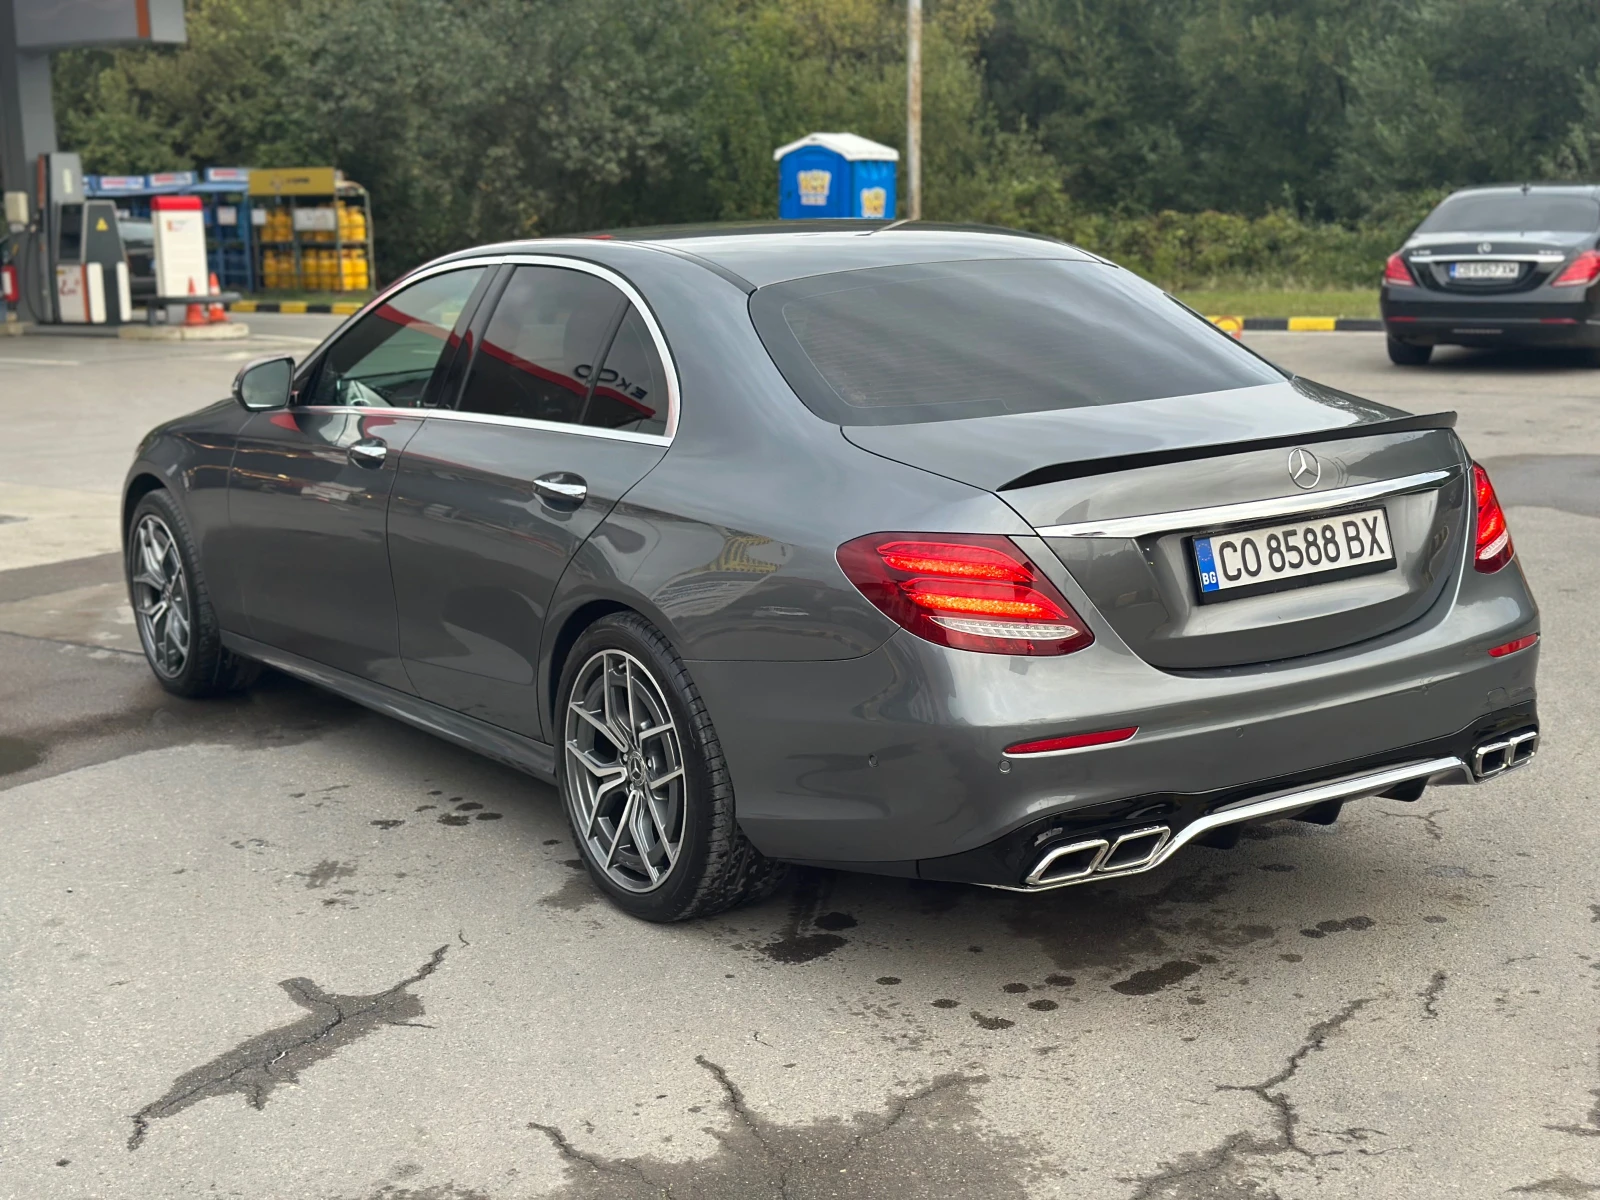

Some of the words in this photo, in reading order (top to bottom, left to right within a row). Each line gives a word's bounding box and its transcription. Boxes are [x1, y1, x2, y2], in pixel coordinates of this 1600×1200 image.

[1219, 537, 1262, 582] CO
[1266, 524, 1341, 573] 8588
[1342, 516, 1385, 559] BX
[1202, 571, 1217, 586] BG
